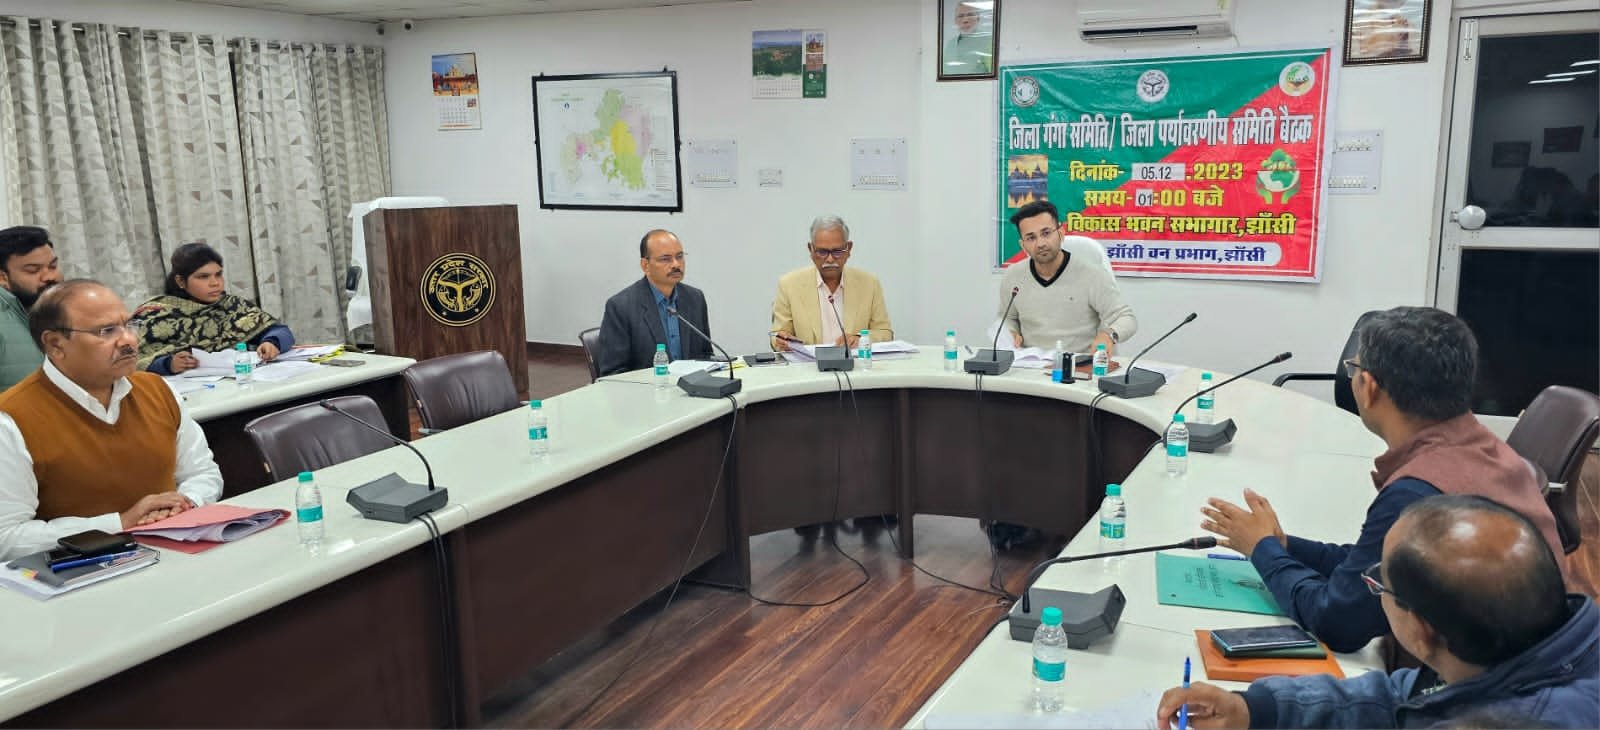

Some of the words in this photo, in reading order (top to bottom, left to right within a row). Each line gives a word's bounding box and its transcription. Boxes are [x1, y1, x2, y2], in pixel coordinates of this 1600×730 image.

[1009, 116, 1040, 150] जिला
[1043, 112, 1067, 149] गंगा
[1121, 112, 1156, 148] जिला
[1158, 109, 1229, 147] पर्यावरणीय
[1232, 107, 1277, 145] समिति
[1141, 166, 1172, 180] 05.12
[1191, 184, 1225, 207] बजे
[1066, 212, 1121, 233] विकास
[1125, 215, 1166, 233] भवन
[1148, 247, 1171, 260] वन
